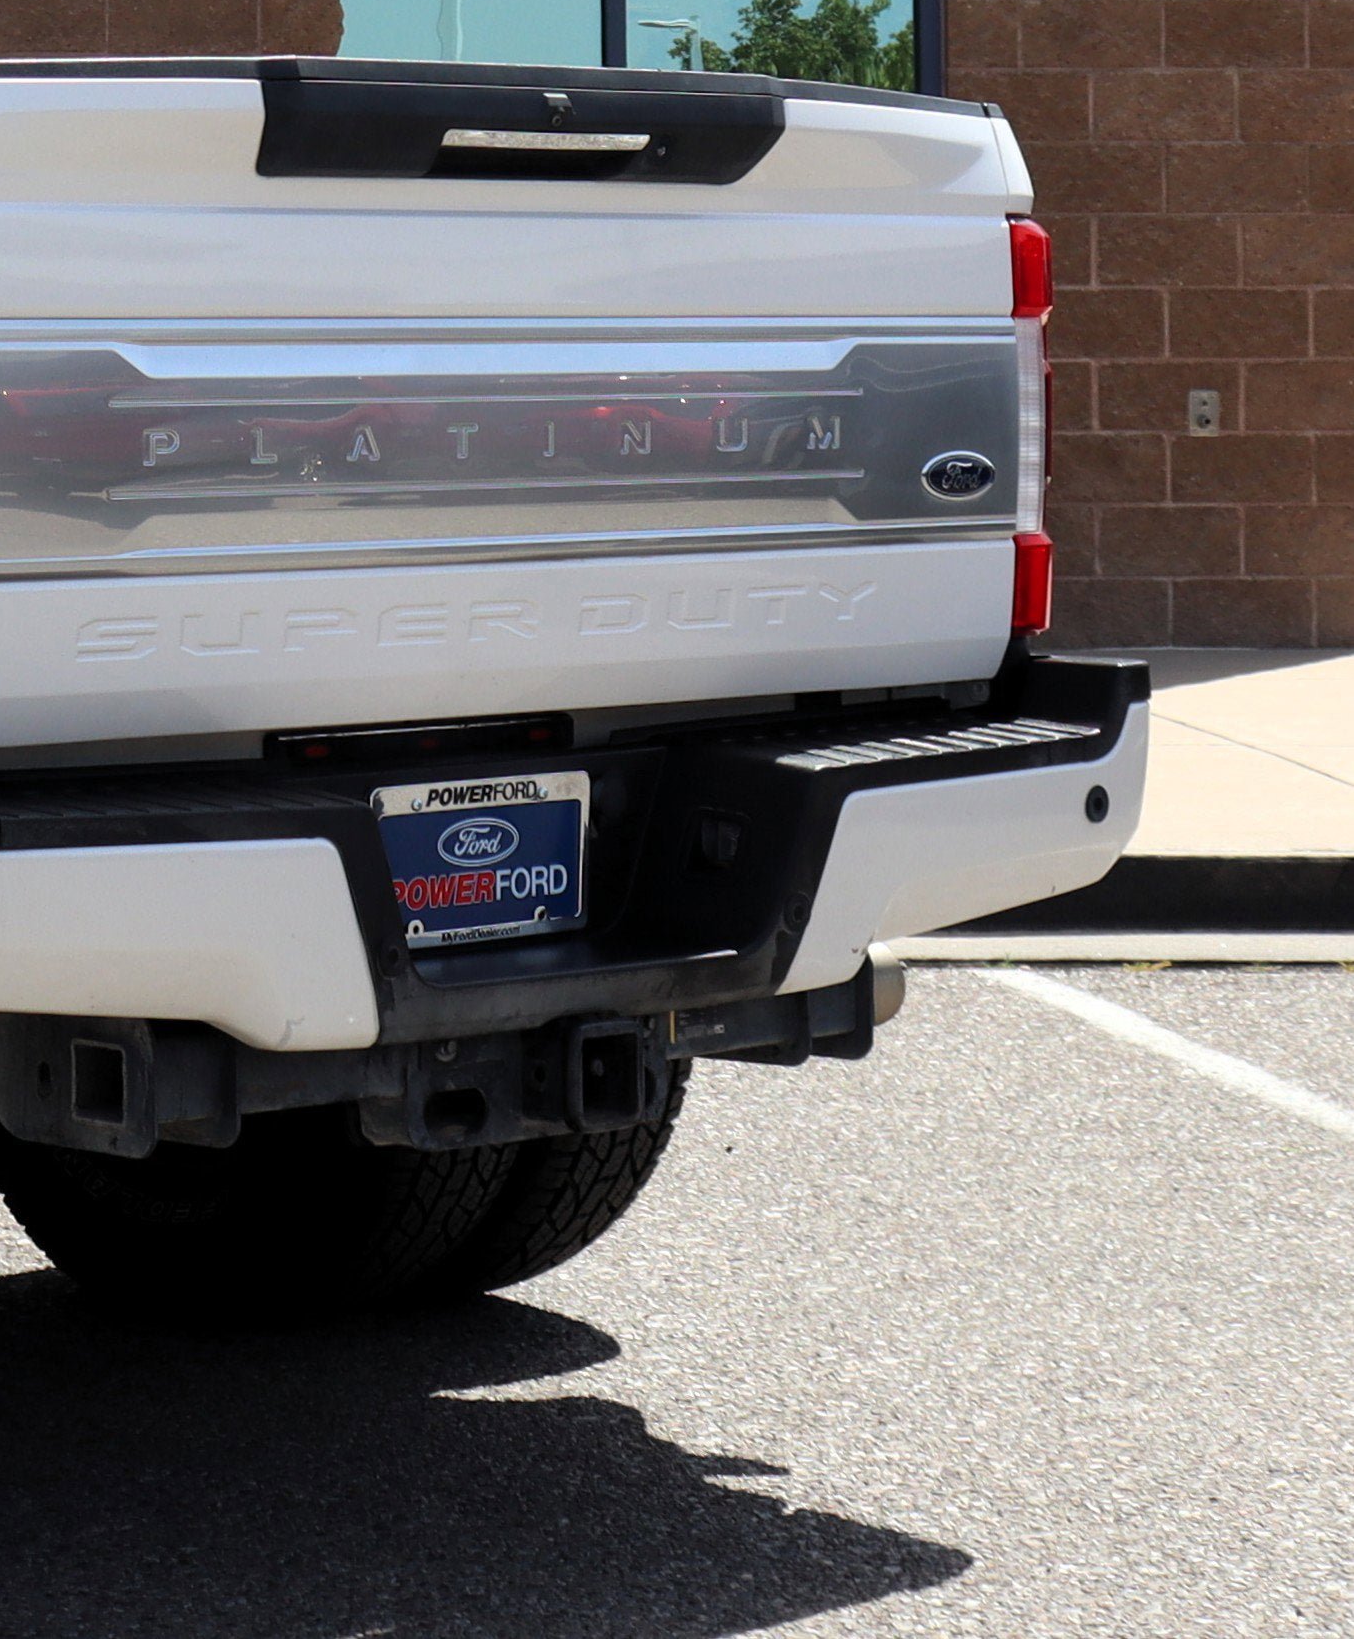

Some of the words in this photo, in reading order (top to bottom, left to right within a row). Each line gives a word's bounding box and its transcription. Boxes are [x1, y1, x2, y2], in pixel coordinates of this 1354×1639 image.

[143, 415, 842, 467] PLATINUM
[942, 461, 983, 490] Ford
[75, 598, 539, 661] SUPER
[579, 579, 878, 636] DUTY
[454, 826, 502, 857] Ford
